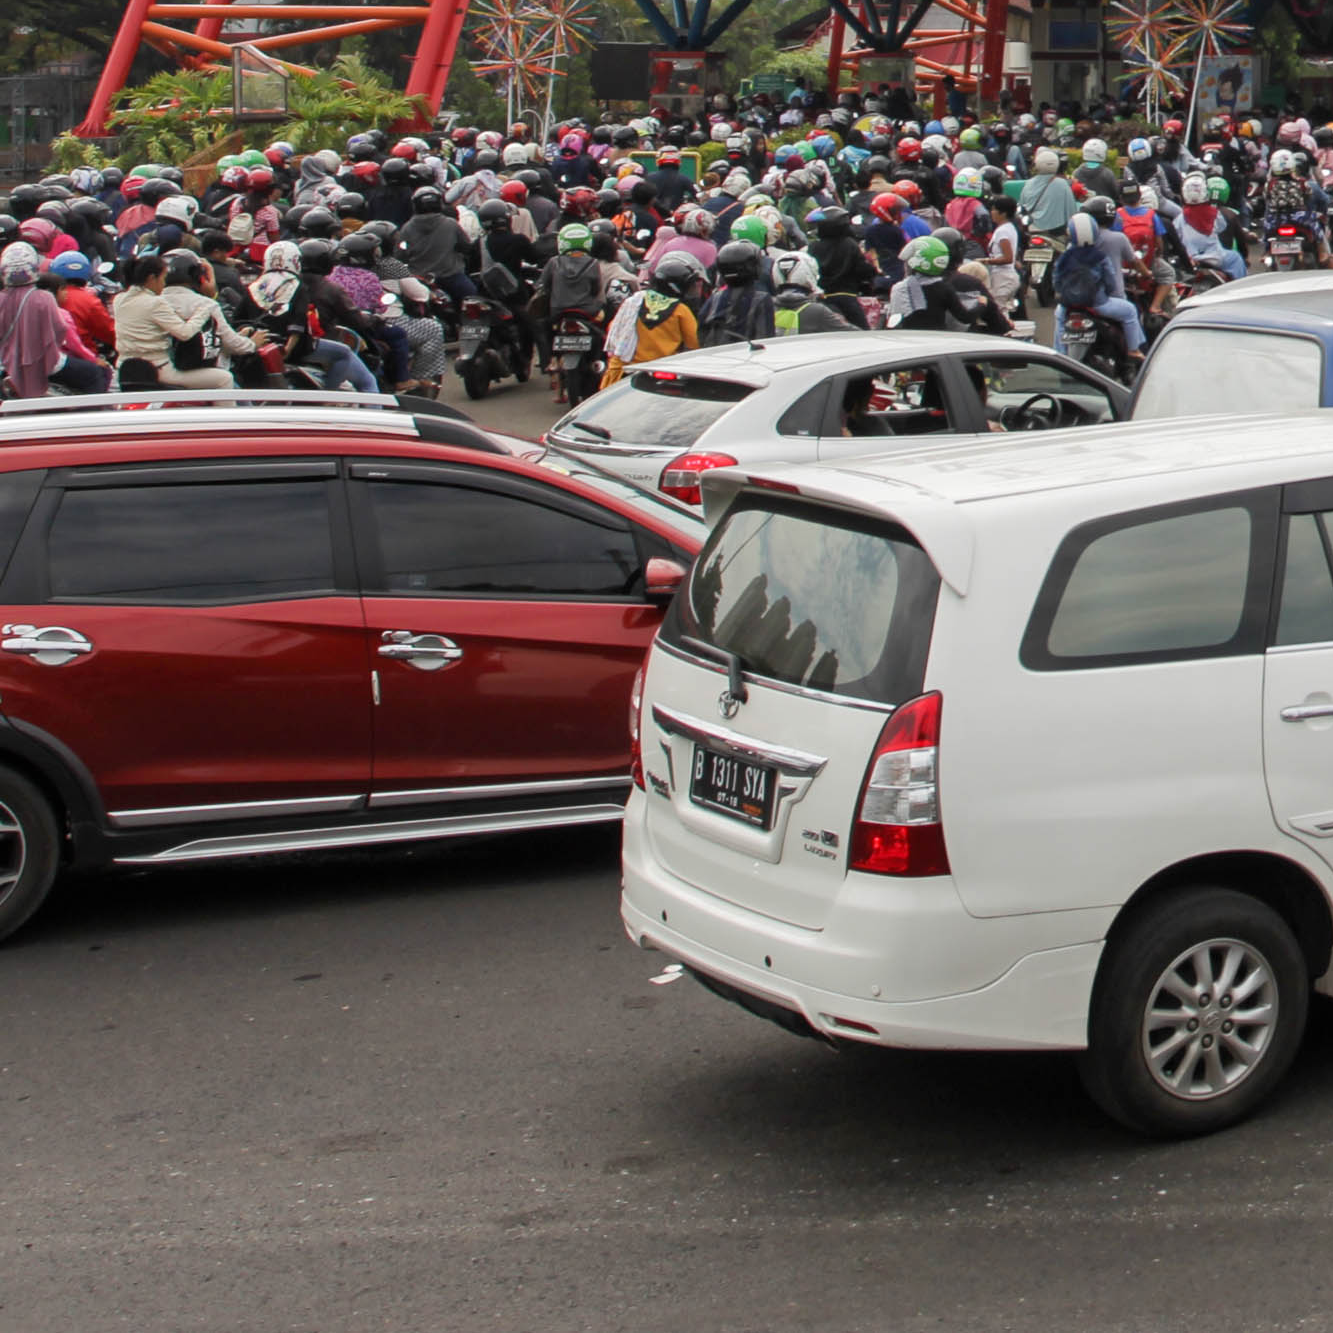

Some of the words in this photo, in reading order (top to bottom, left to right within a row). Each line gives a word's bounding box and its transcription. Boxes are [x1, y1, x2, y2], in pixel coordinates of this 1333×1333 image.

[695, 750, 705, 781] B
[711, 755, 739, 792] 1311
[744, 767, 767, 802] SYA
